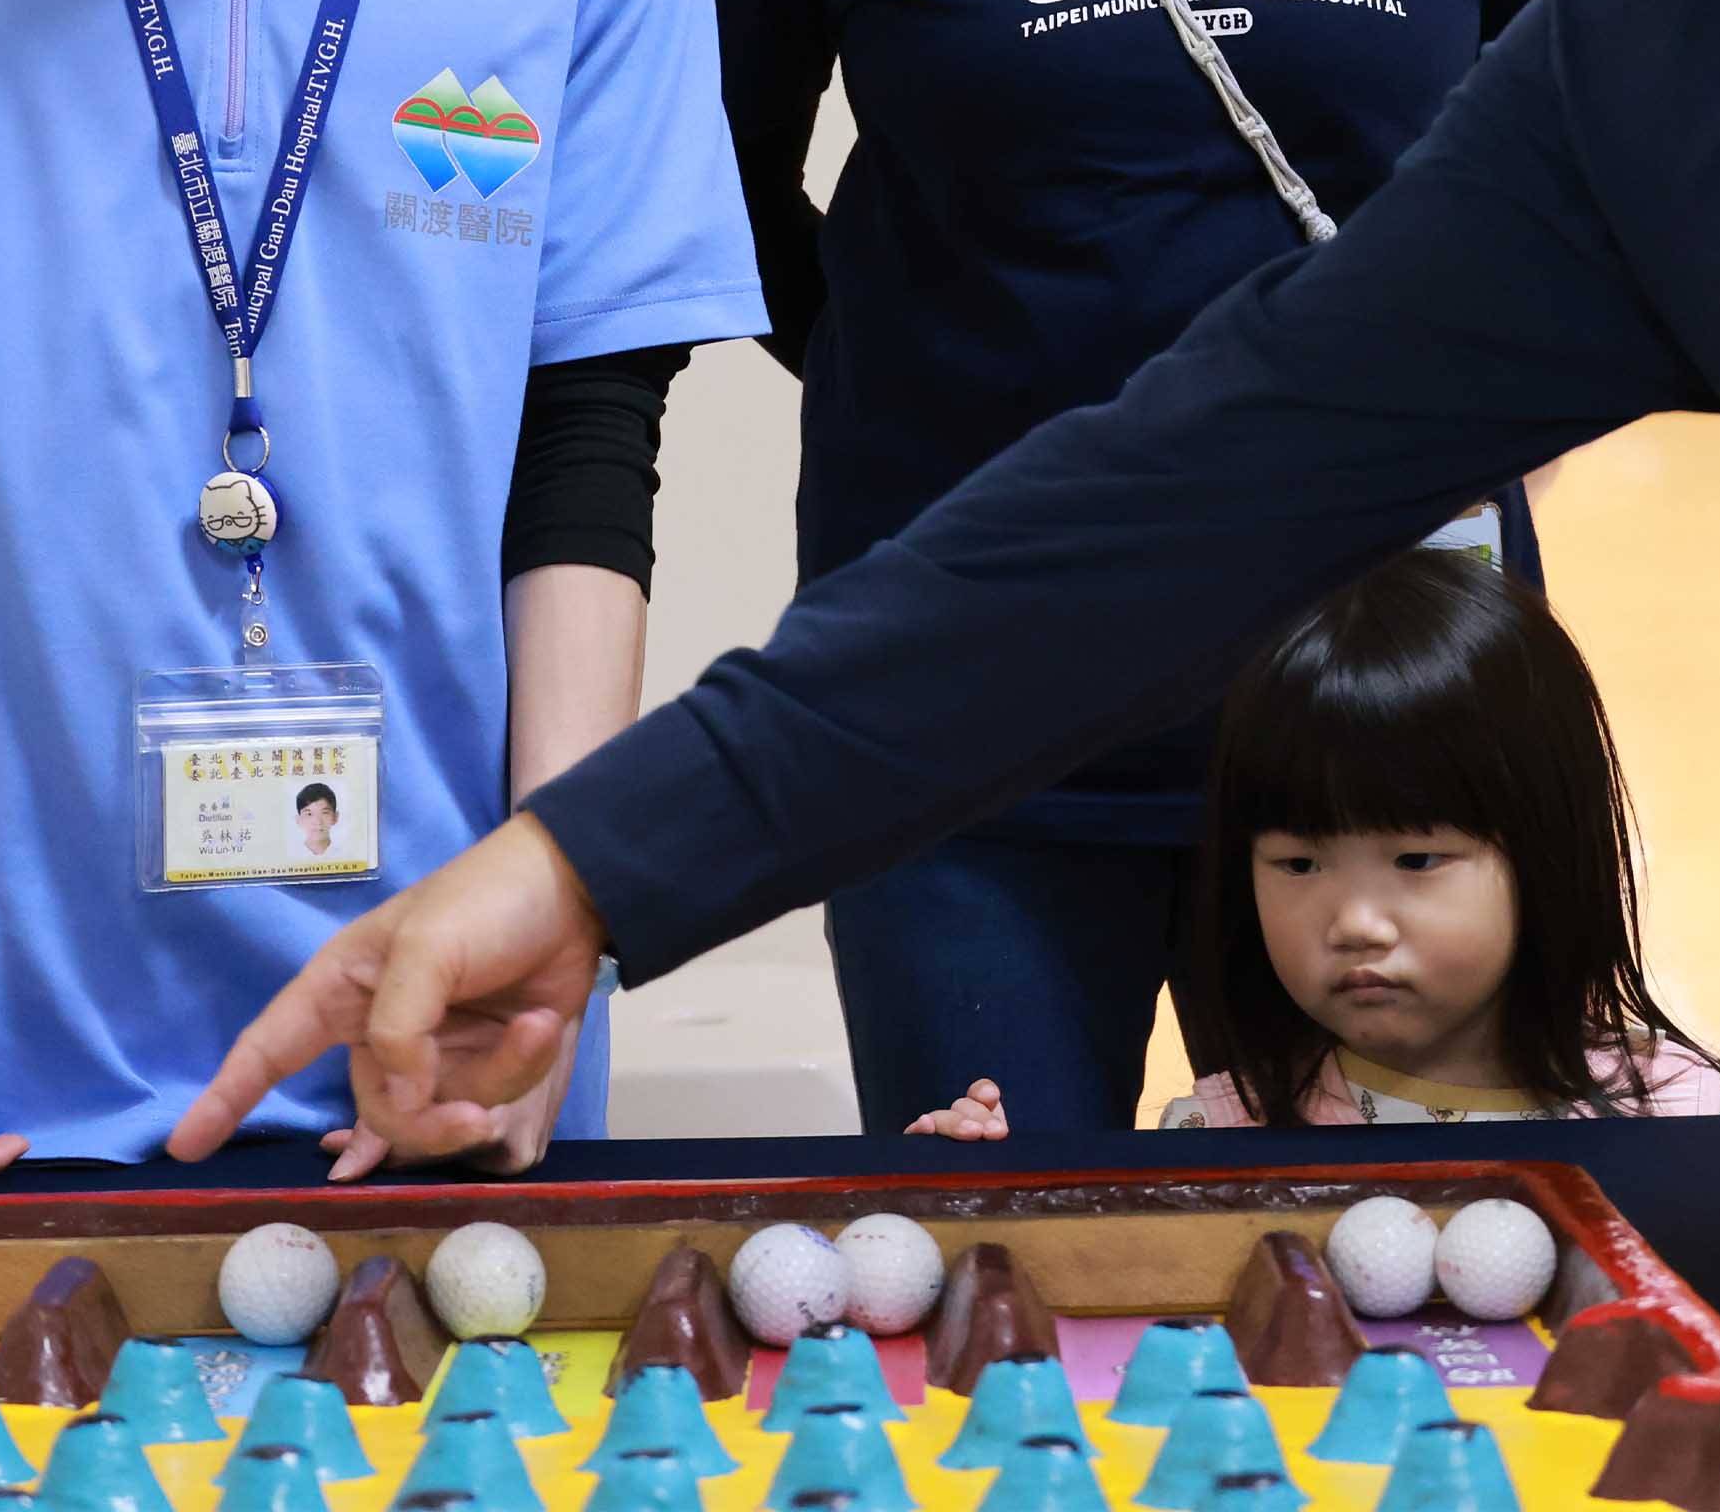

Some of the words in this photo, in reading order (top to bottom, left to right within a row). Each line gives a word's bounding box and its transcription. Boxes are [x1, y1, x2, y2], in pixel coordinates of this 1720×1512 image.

[1021, 6, 1089, 38] TAIPEI
[1195, 13, 1248, 31] VGH
[259, 175, 299, 260] Gan-Dau
[284, 17, 346, 173] Hospital-T.V.G.H.
[171, 130, 239, 312] 臺北市立關渡醫院
[384, 191, 535, 248] 關渡醫院
